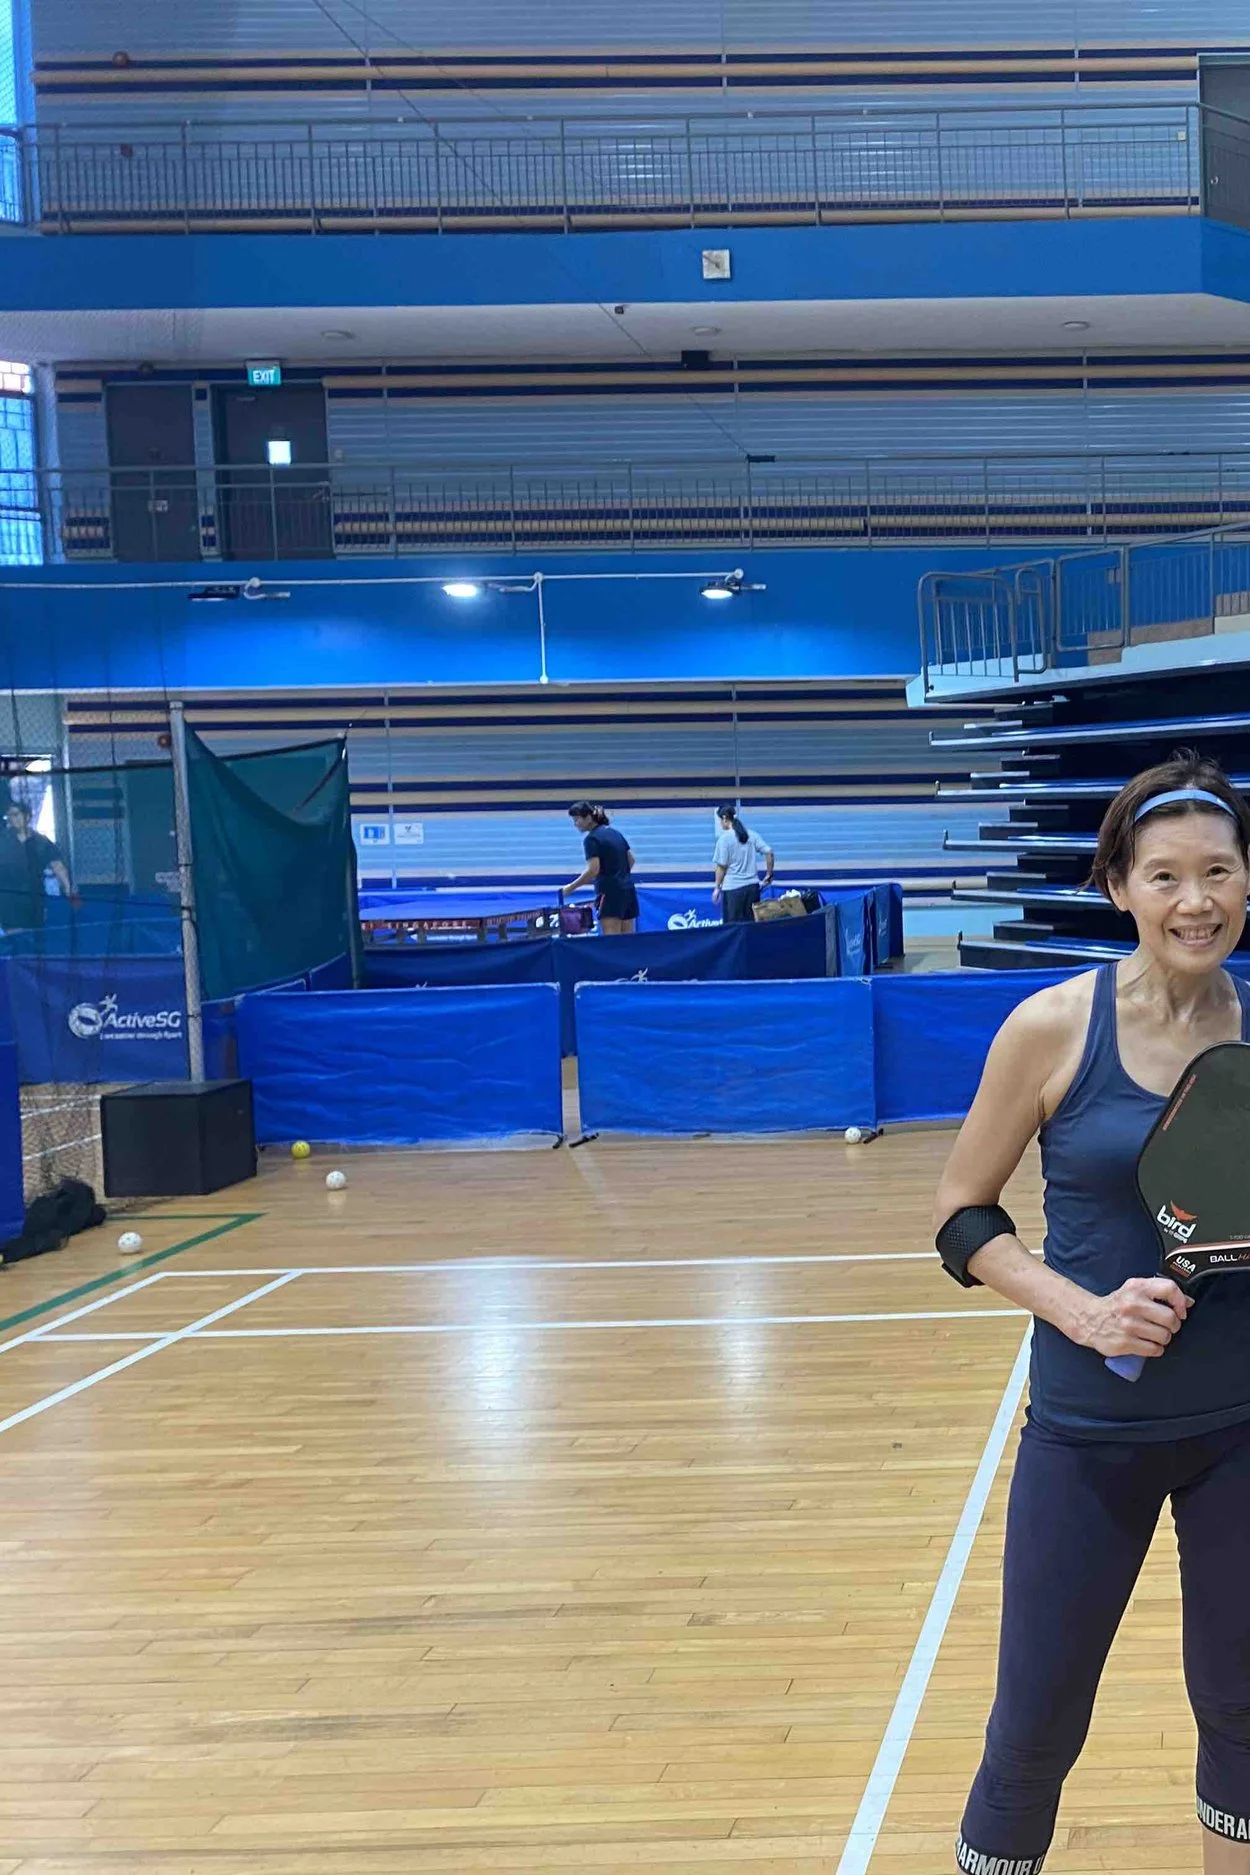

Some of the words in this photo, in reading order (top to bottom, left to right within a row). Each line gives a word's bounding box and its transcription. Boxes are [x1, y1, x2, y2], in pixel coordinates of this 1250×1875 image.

[252, 369, 275, 384] EXIT
[103, 1011, 182, 1028] ActiveSG
[1157, 1204, 1197, 1238] bird
[1176, 1256, 1197, 1273] USA
[1209, 1254, 1238, 1263] BALL
